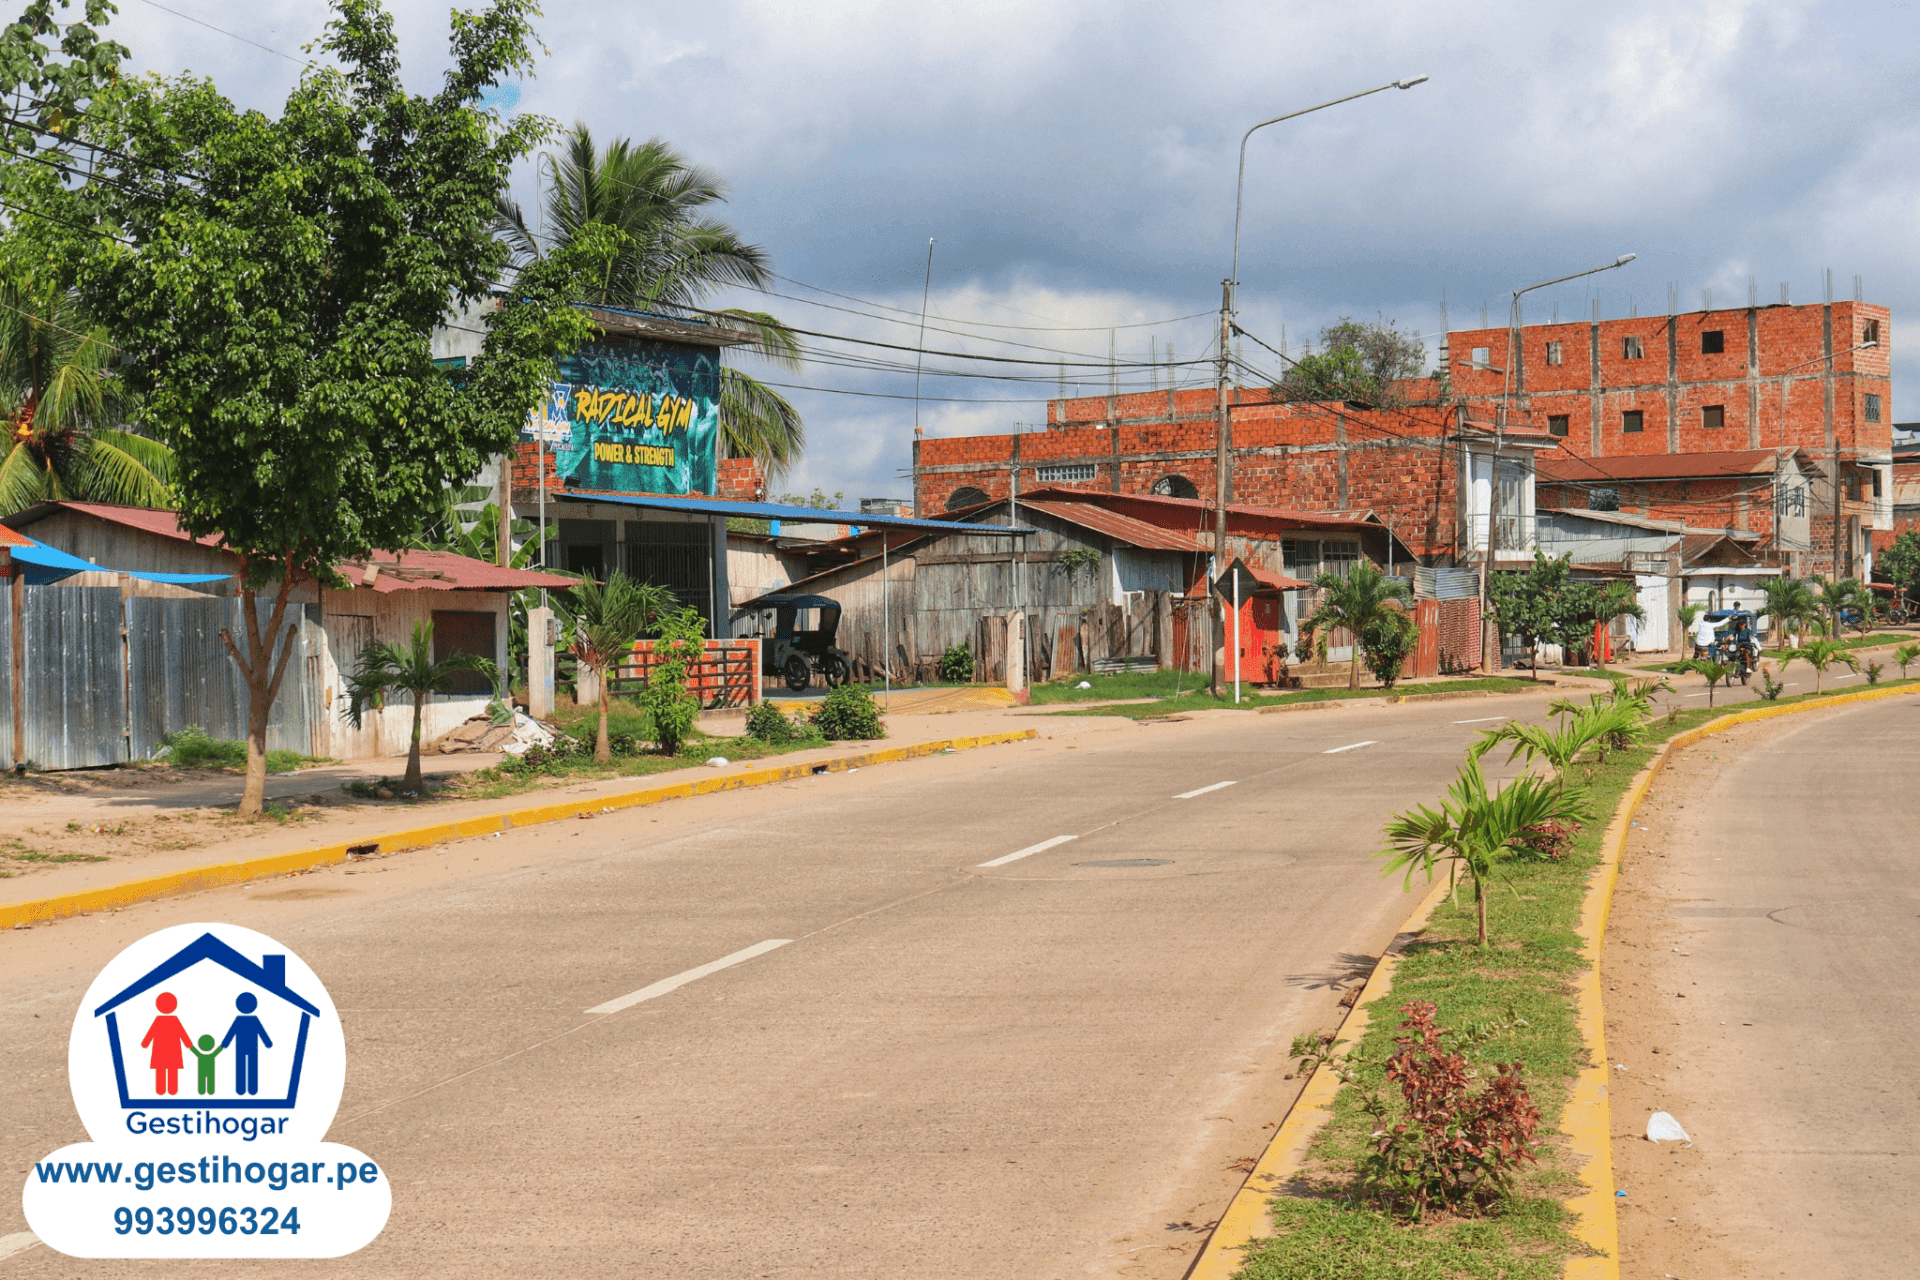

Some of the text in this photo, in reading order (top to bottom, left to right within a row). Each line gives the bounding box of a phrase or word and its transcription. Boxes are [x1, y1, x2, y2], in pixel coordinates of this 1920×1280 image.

[574, 387, 692, 436] RADICAL GYM
[594, 442, 675, 467] POWER & STRENGTH
